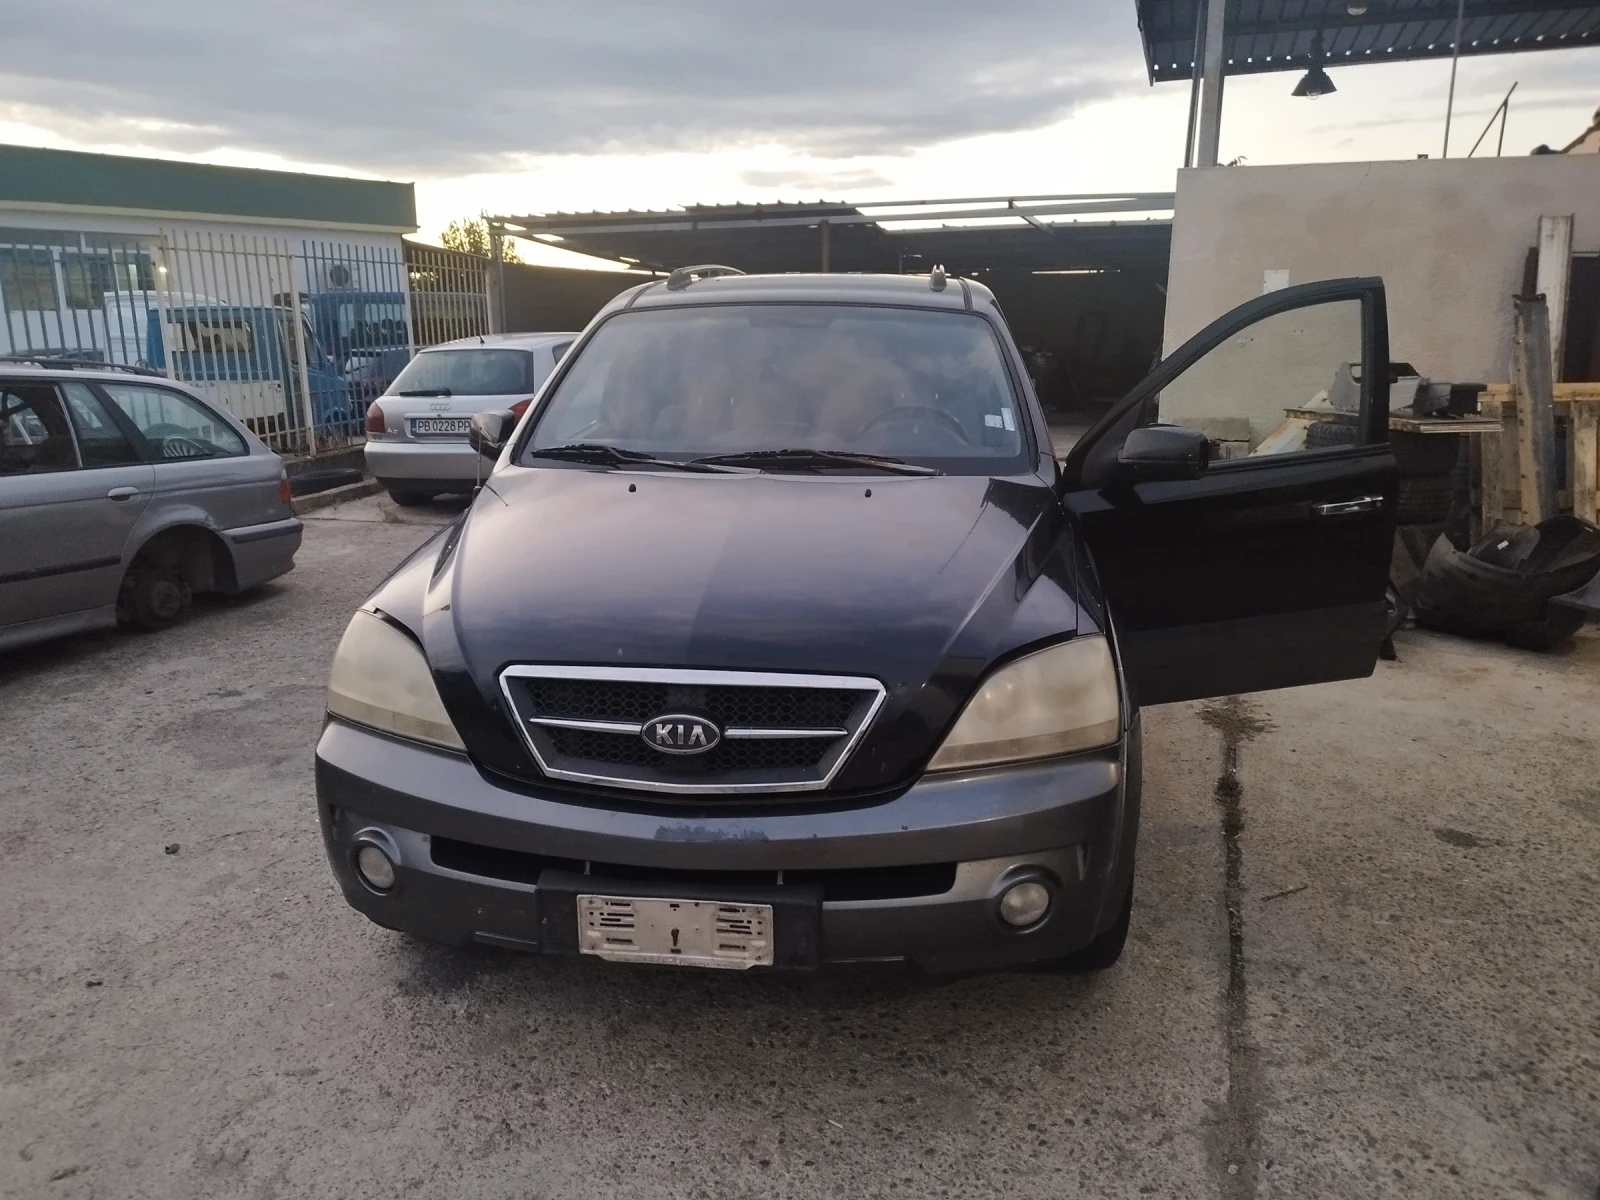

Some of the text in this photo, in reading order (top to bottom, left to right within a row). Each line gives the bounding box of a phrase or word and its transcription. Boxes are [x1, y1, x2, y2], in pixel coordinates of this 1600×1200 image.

[418, 420, 430, 431] PB
[432, 420, 456, 432] 0228
[457, 420, 471, 431] PP
[655, 723, 708, 746] KIA
